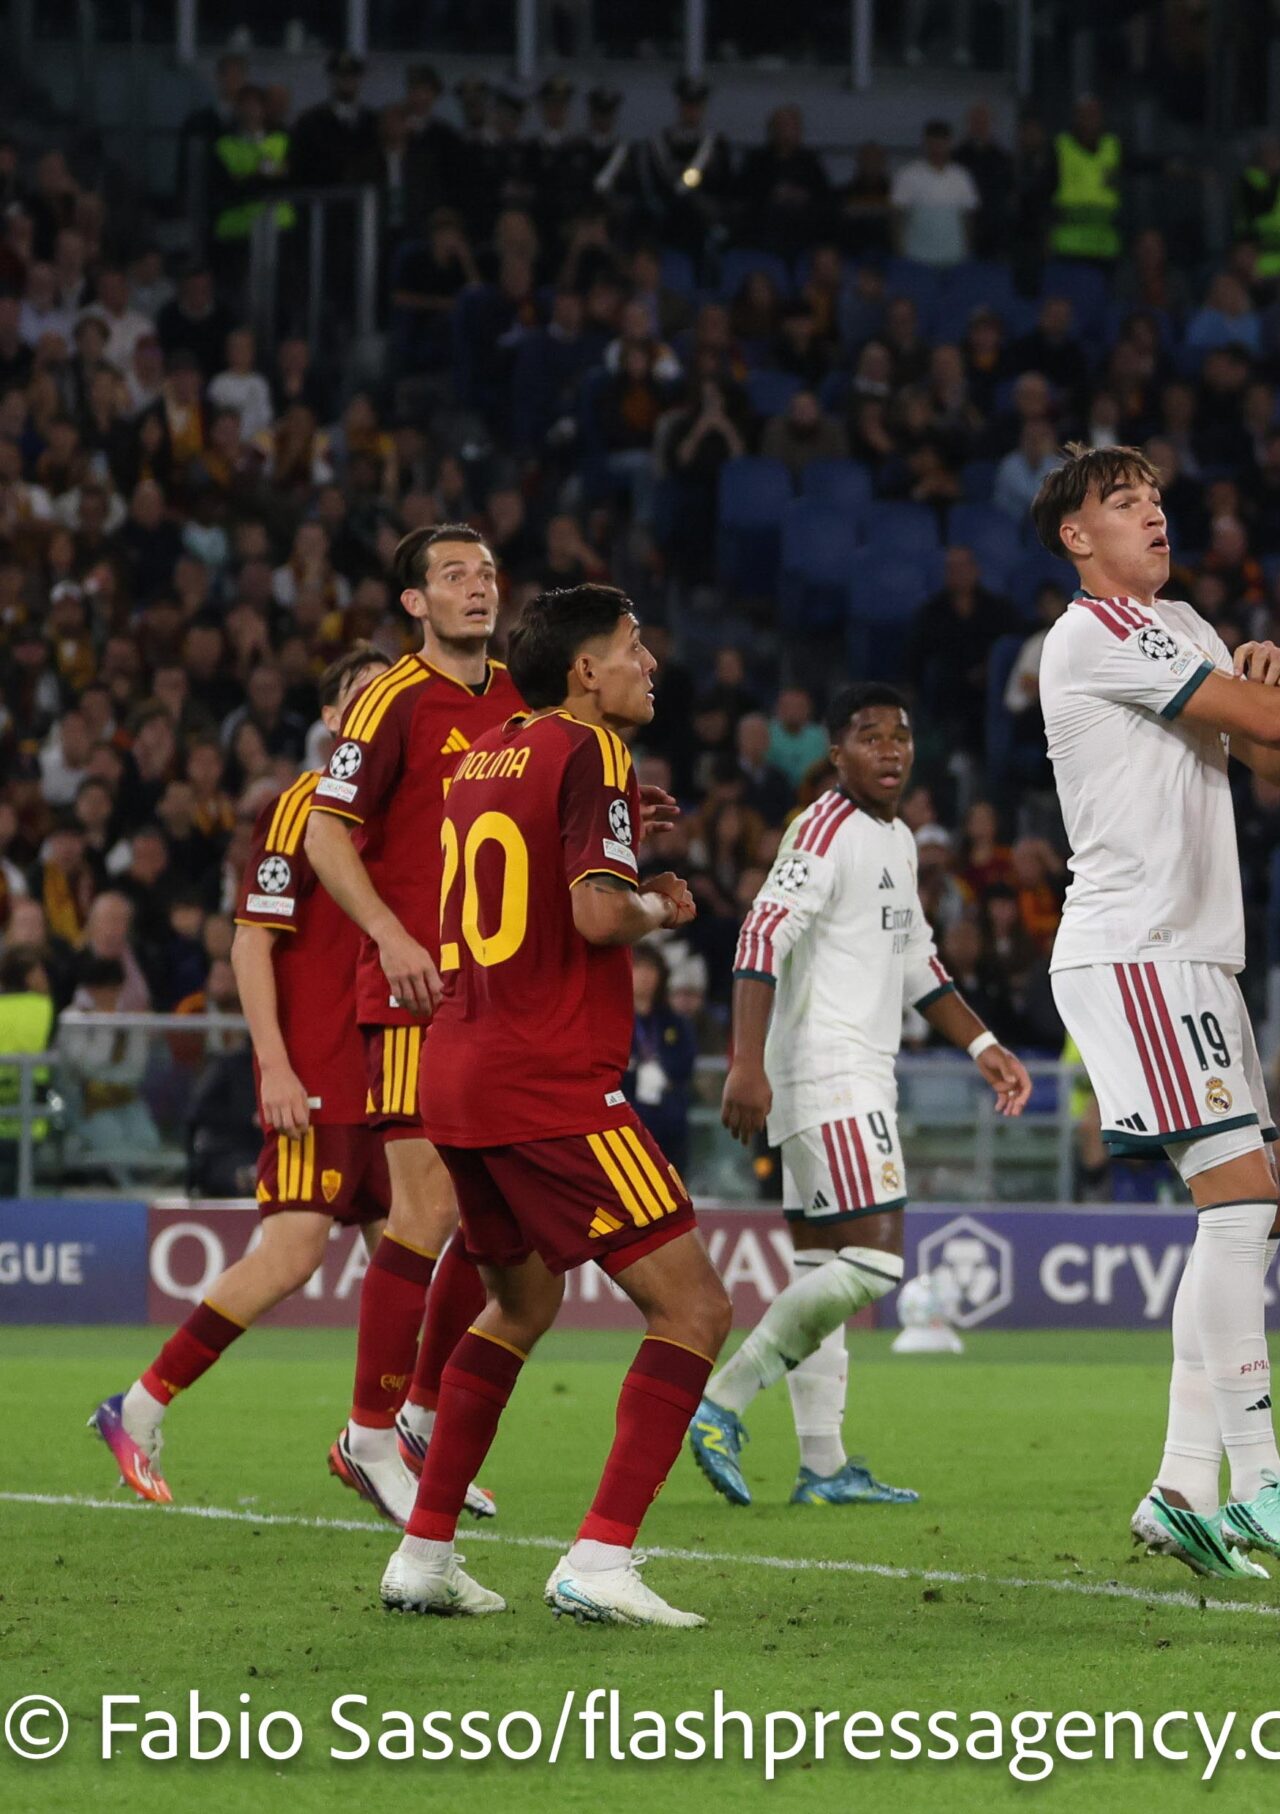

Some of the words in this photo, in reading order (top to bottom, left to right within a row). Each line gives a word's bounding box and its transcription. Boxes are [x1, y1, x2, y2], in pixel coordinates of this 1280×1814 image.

[440, 811, 529, 973] 20
[1181, 1011, 1231, 1072] 19
[867, 1110, 893, 1155] 9
[0, 1241, 83, 1285] GUE
